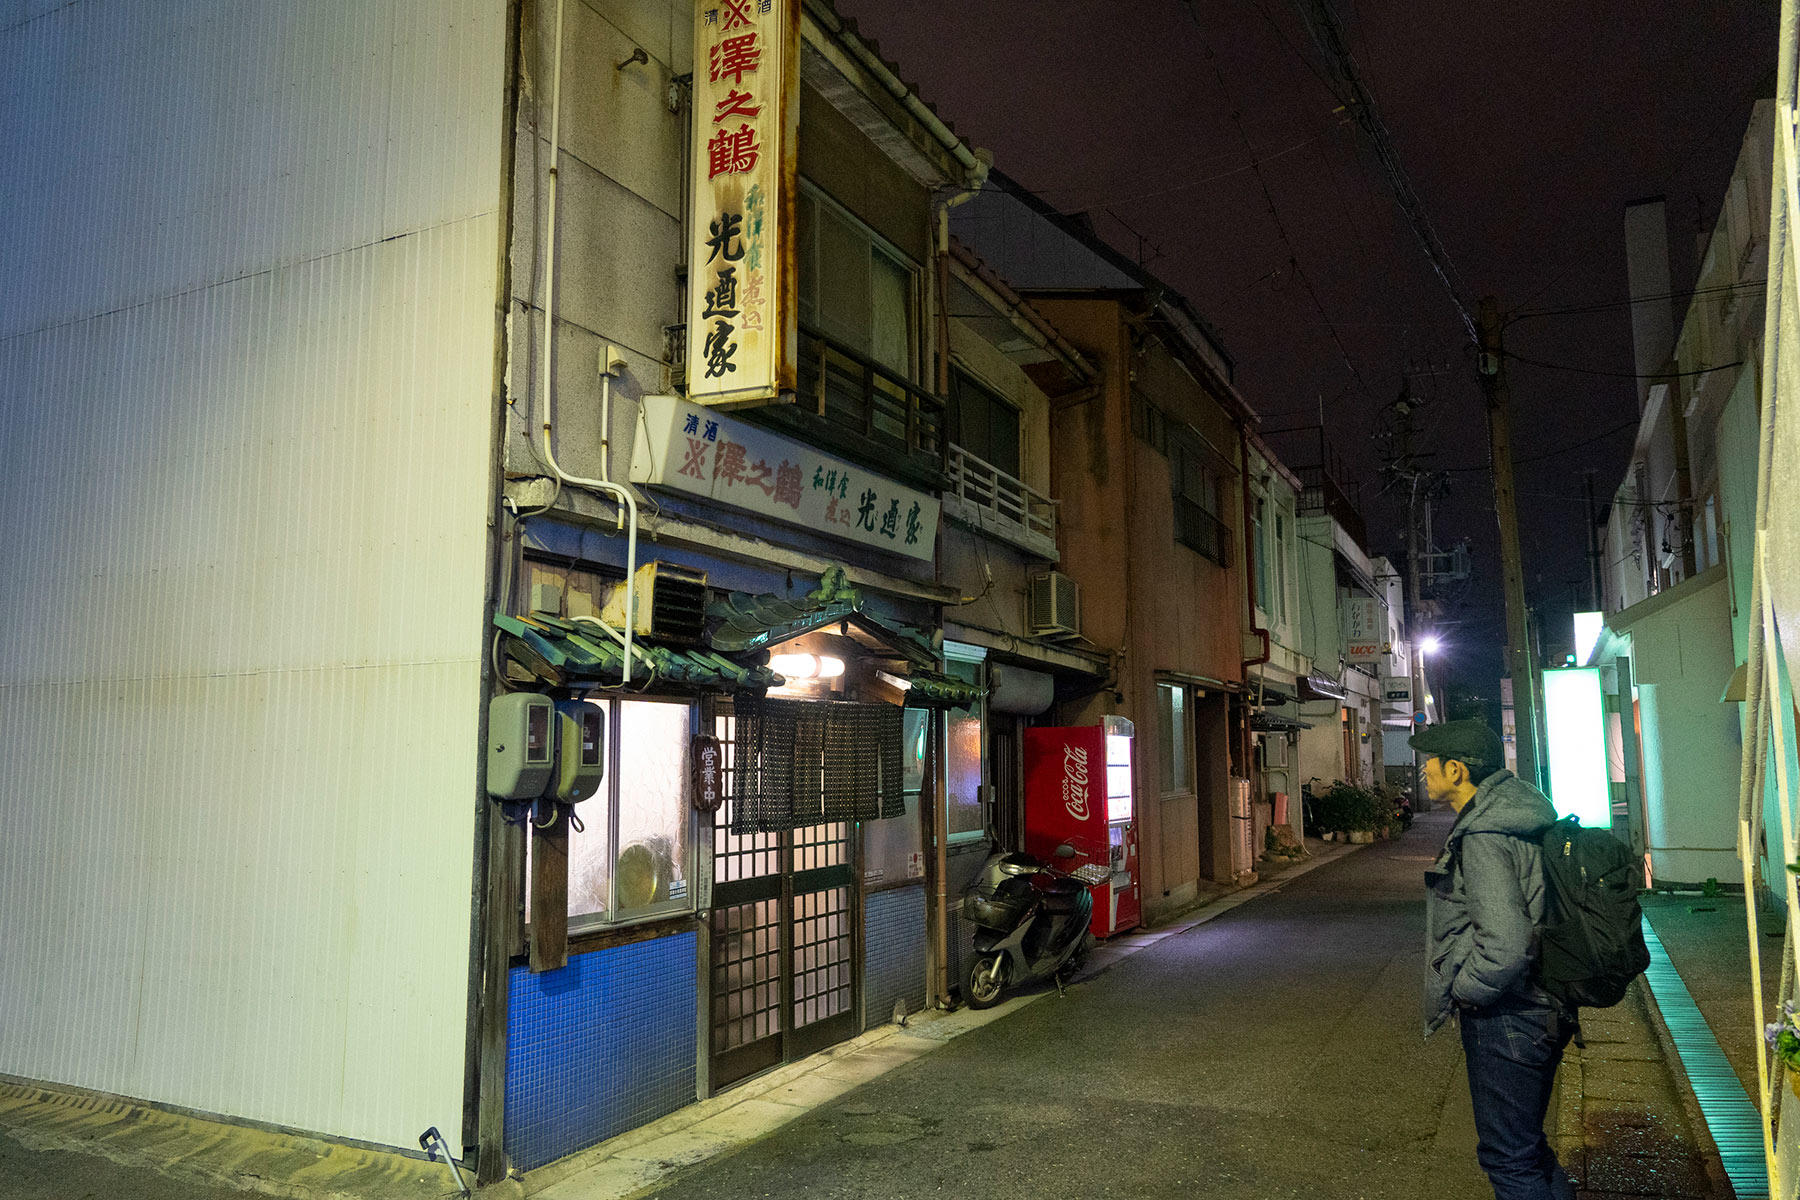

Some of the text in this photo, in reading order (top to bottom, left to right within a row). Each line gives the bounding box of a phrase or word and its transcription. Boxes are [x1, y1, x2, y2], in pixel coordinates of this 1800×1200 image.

[683, 413, 719, 442] 清酒
[701, 746, 718, 806] 営業中
[1063, 743, 1090, 821] Coca-Cola
